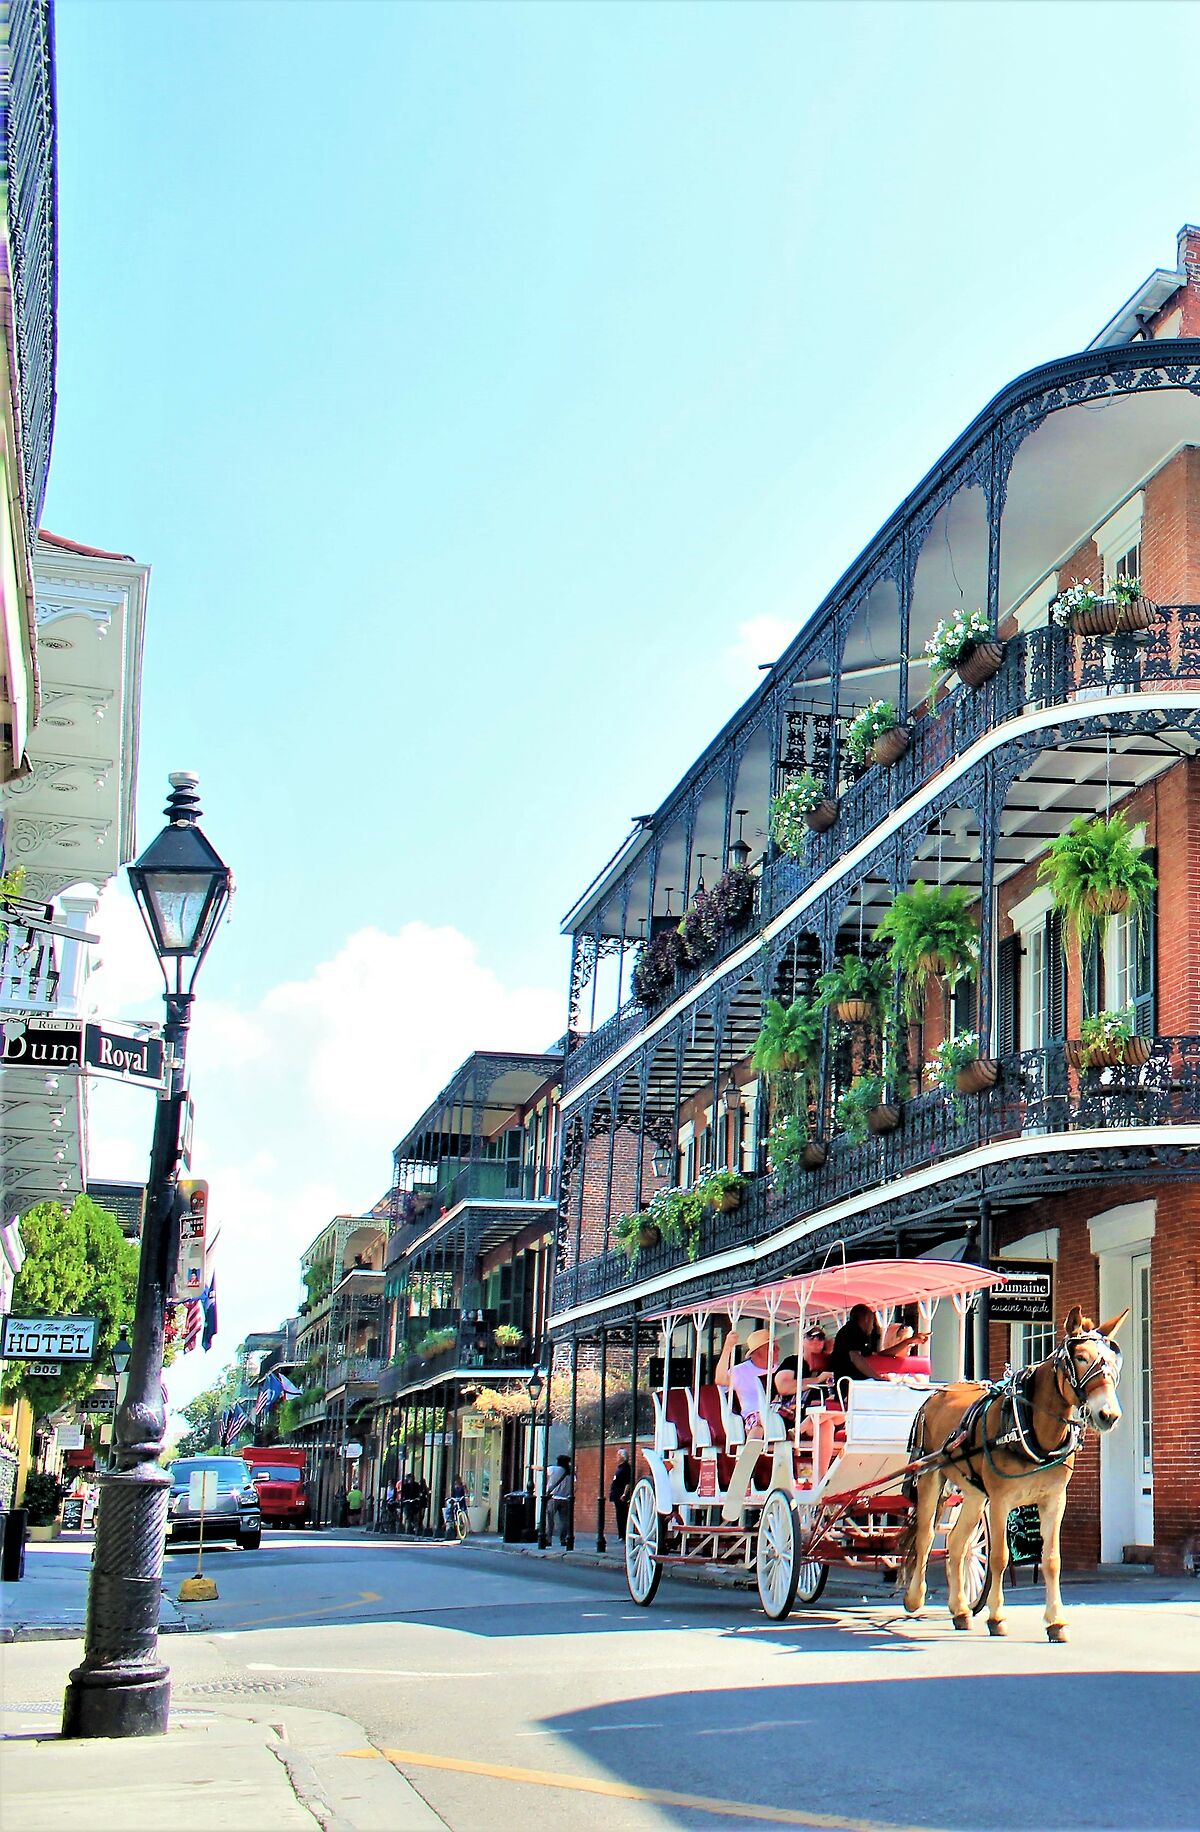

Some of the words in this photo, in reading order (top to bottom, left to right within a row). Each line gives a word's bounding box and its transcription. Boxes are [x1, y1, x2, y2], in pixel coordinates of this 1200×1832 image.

[39, 1021, 60, 1030] Rue
[100, 1037, 148, 1072] Royal
[994, 1281, 1046, 1293] Dumaine
[991, 1303, 1021, 1313] cuisine
[1022, 1302, 1049, 1319] rapide
[10, 1321, 32, 1331] Nine
[62, 1323, 91, 1334] Royal
[7, 1333, 90, 1353] HOTEL
[34, 1365, 58, 1374] 905
